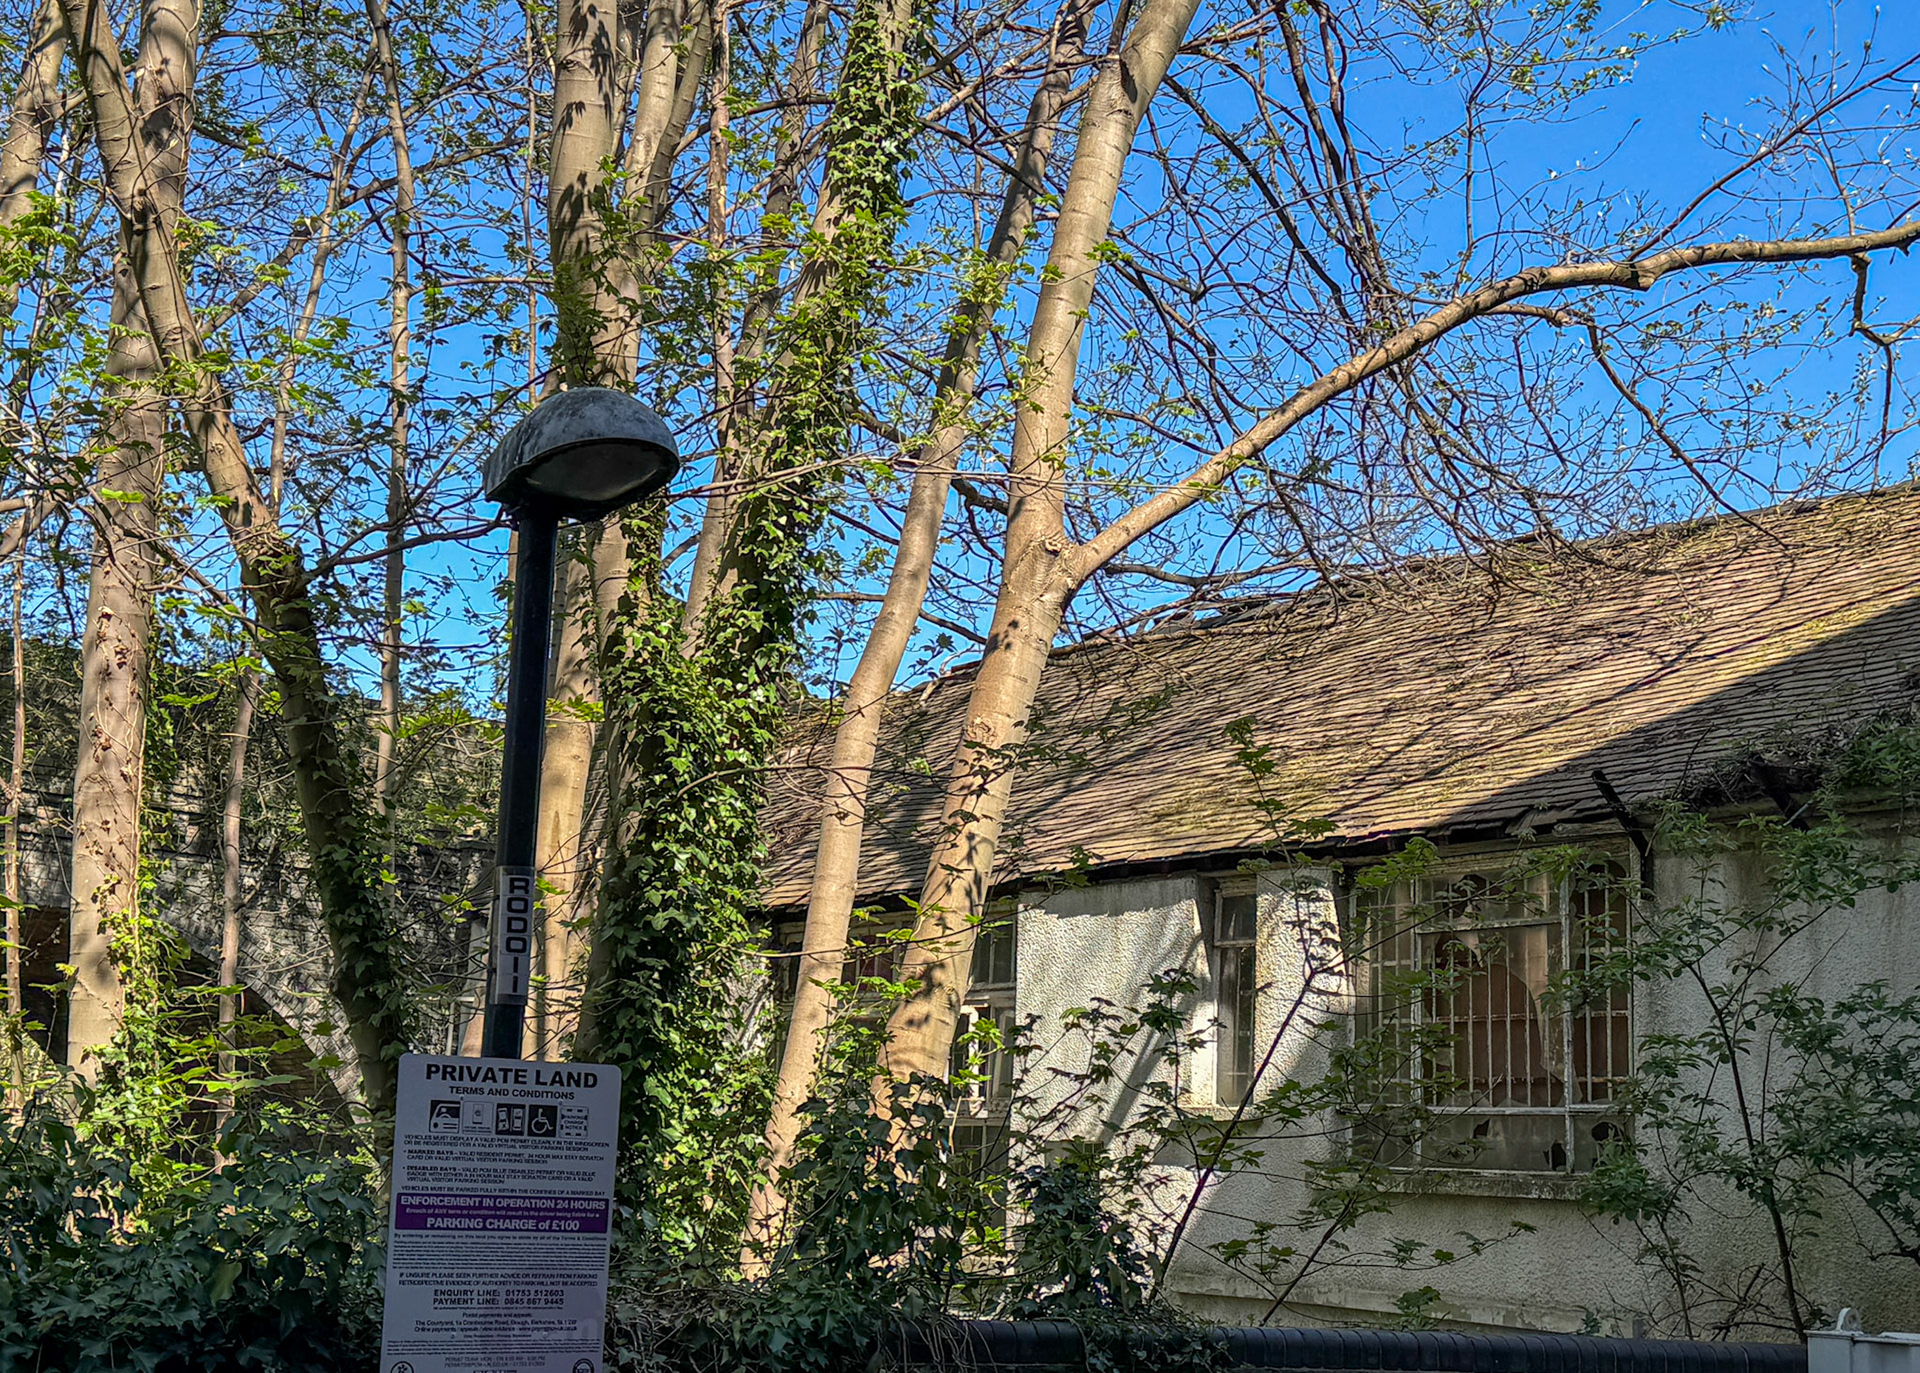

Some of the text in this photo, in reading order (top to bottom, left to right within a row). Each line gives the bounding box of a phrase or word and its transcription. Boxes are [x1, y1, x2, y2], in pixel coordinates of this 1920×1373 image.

[426, 1064, 598, 1088] PRIVATE LAND
[449, 1087, 575, 1099] TERMS AND CONDITIONS
[401, 1196, 606, 1210] ENFORCEMENT IN OPERATION 24 HOURS
[427, 1218, 580, 1231] PARKING CHARGE of £100
